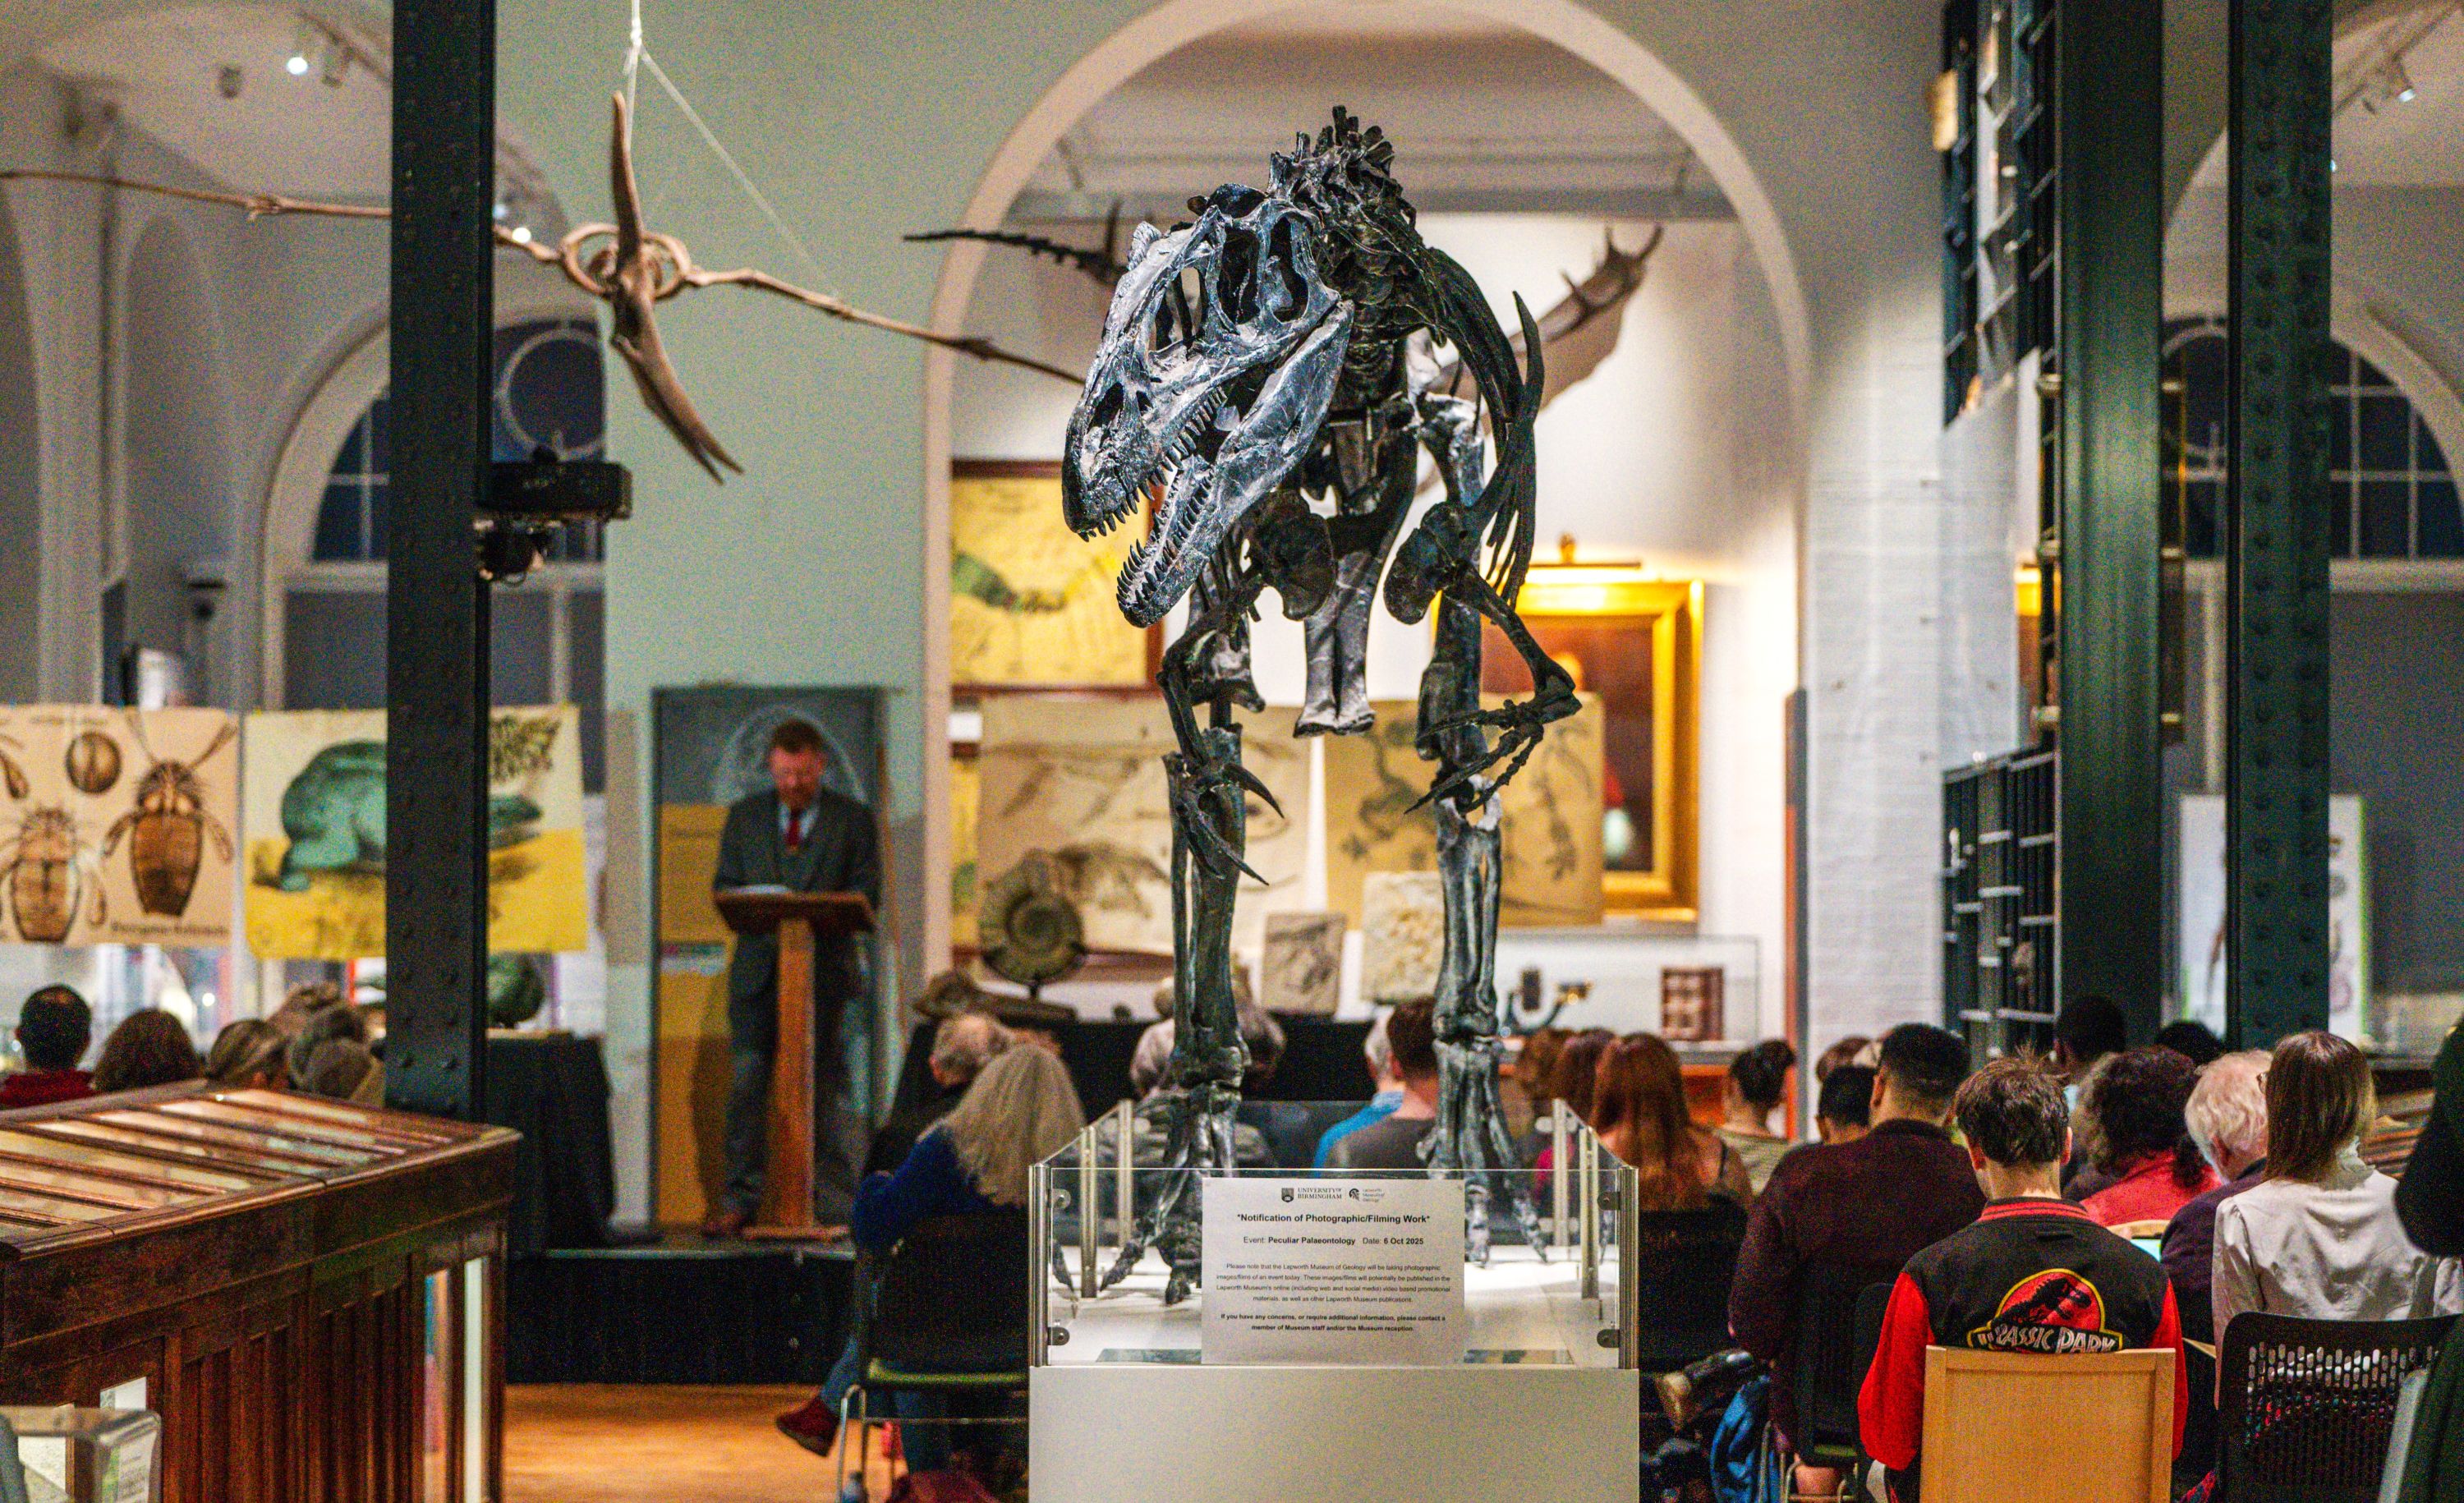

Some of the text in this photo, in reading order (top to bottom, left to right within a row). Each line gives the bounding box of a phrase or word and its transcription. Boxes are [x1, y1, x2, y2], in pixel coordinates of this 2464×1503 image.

[1294, 1214, 1303, 1222] of
[1305, 1214, 1401, 1225] Photographic/Filming
[1301, 1236, 1356, 1246] Palaeontology
[2056, 1326, 2117, 1354] PARK
